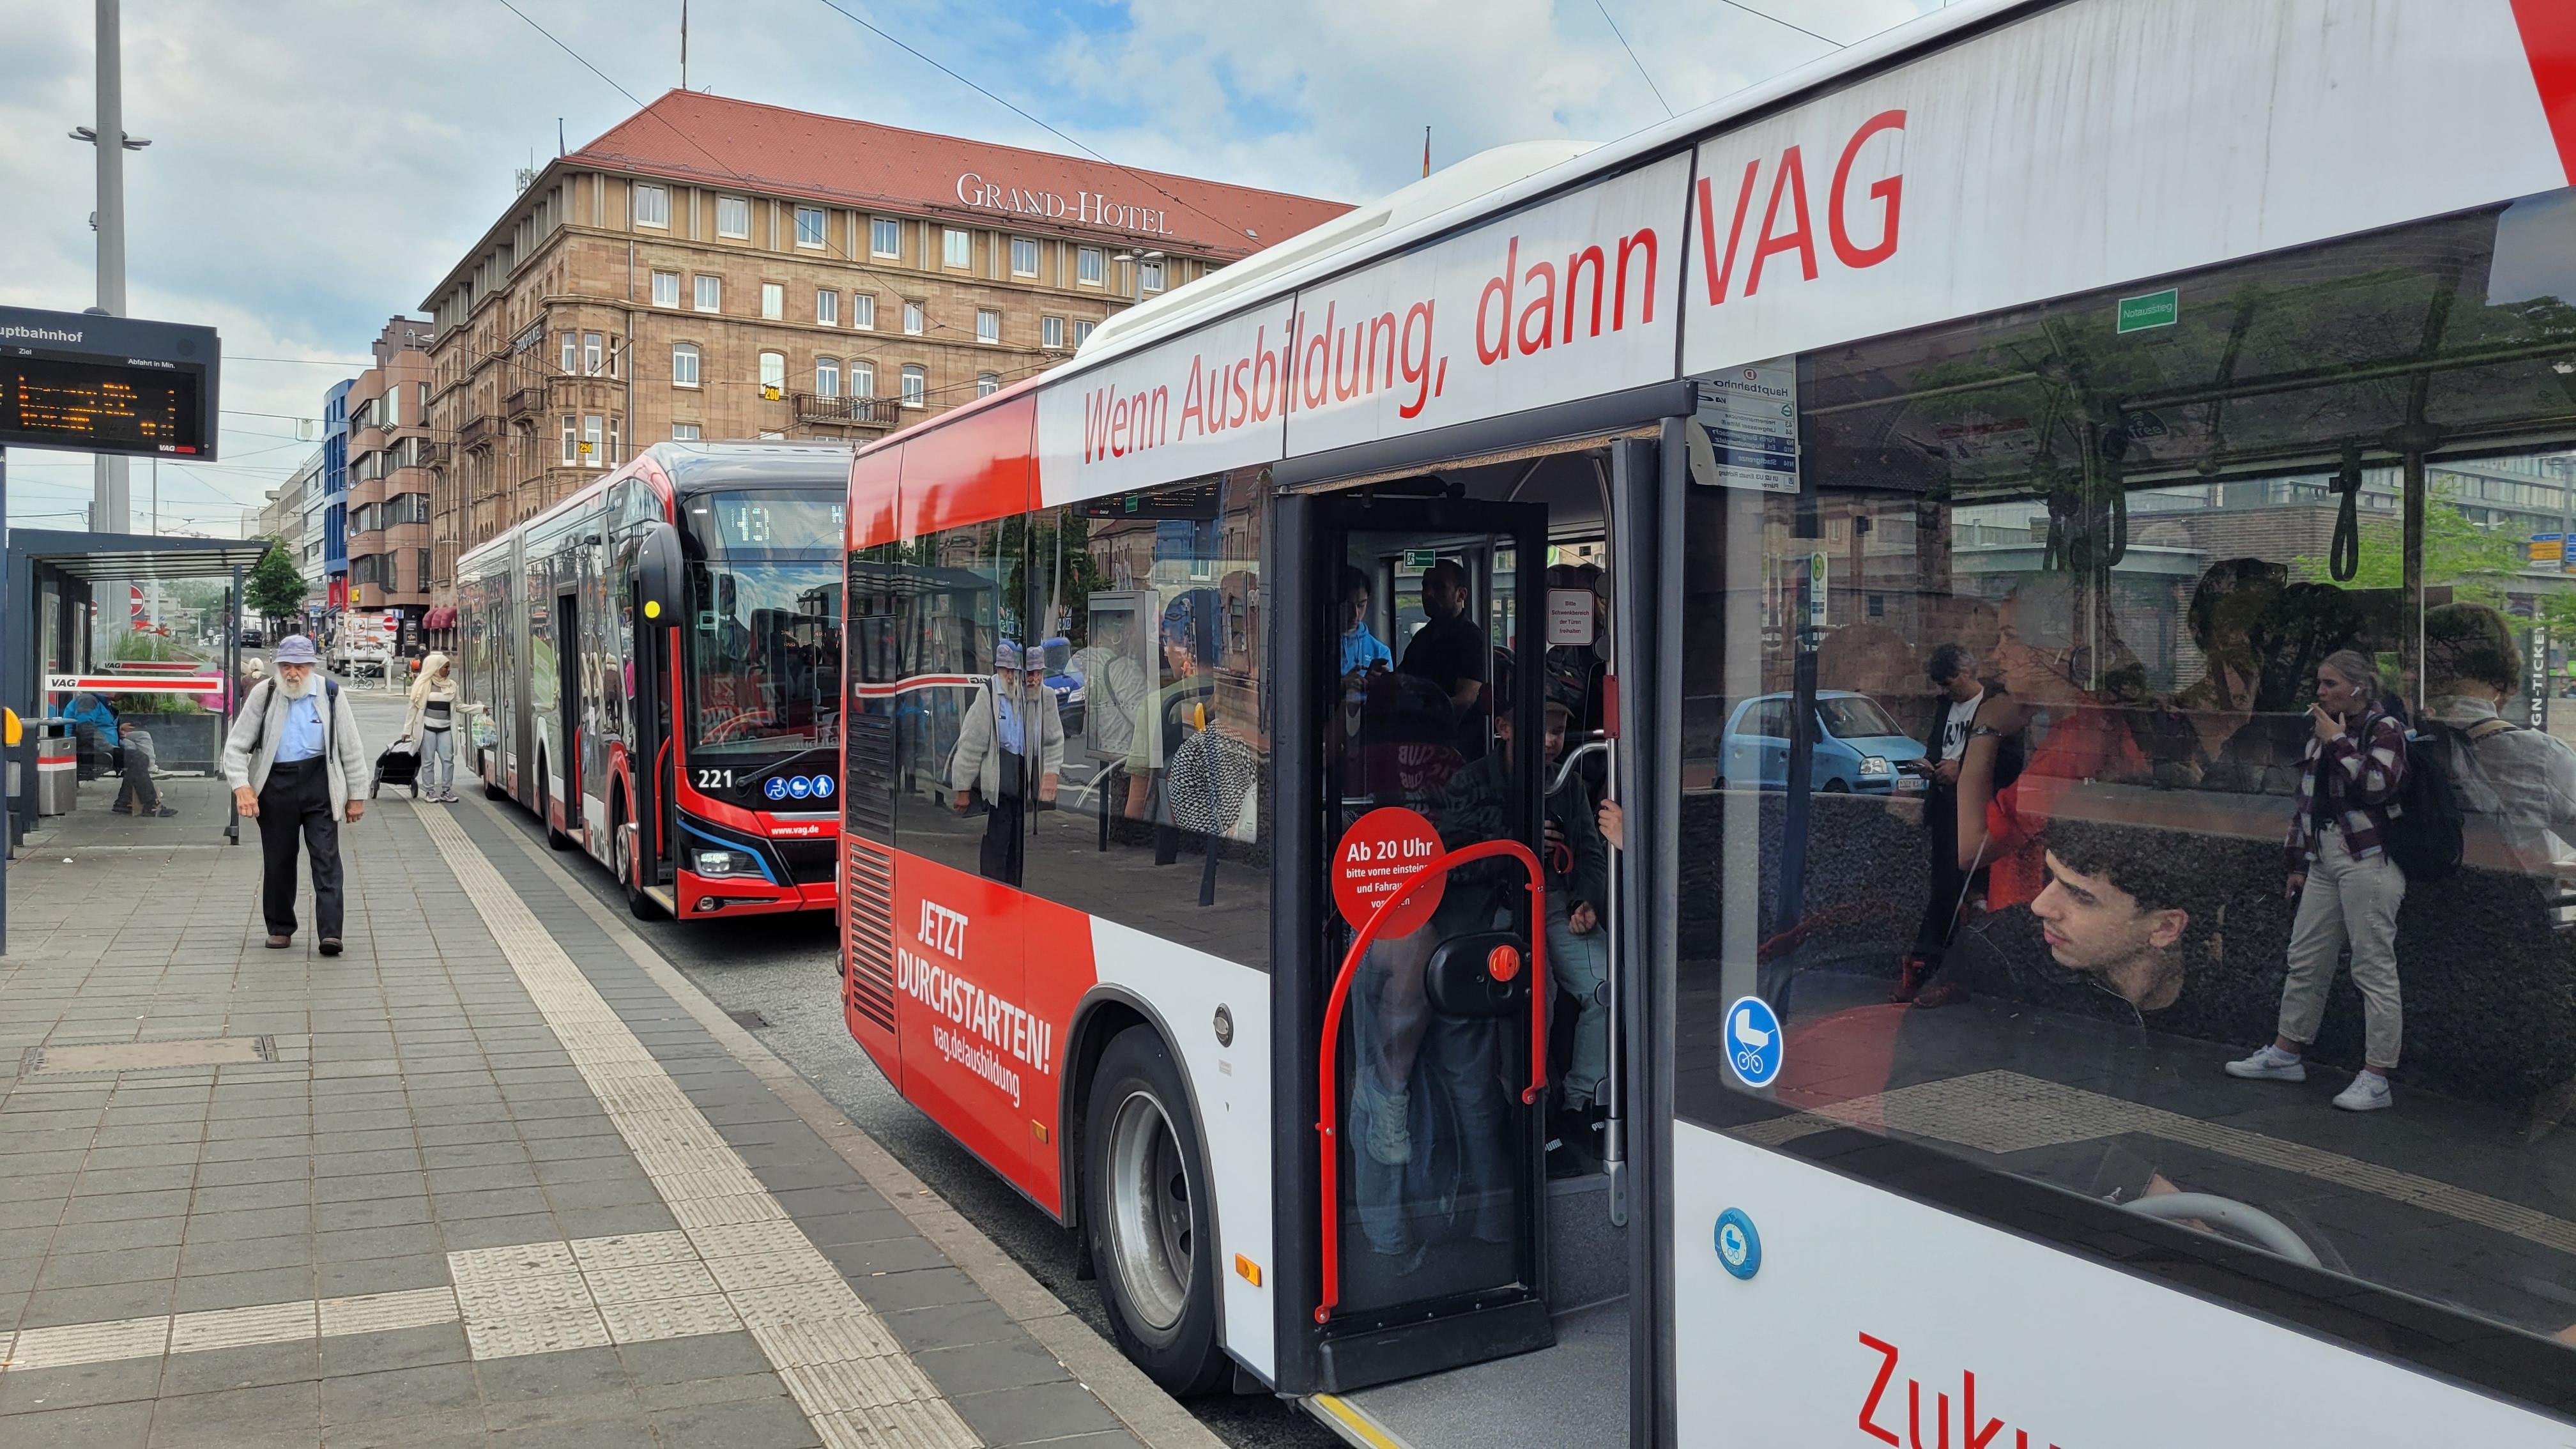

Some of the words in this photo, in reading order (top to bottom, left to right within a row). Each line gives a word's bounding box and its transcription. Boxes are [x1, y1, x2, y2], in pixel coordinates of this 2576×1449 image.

[956, 173, 1174, 235] GRAND-HOTEL
[1084, 381, 1167, 464] Wenn
[1177, 298, 1448, 441] Ausbildung,
[1475, 226, 1659, 366] dann
[1696, 109, 1908, 306] VAG
[128, 358, 153, 367] Abfahrt
[765, 387, 779, 401] 260
[579, 442, 592, 453] 250
[51, 679, 76, 687] VAG
[698, 769, 732, 788] 221
[771, 825, 819, 836] www.vag.de
[1346, 841, 1371, 862] Ab
[1376, 840, 1397, 859] 20
[1403, 838, 1433, 857] Uhr
[1346, 868, 1366, 878] bitte
[1368, 868, 1391, 876] vorne
[1357, 883, 1372, 894] und
[918, 899, 969, 960] JETZT
[898, 947, 1051, 1075] DURCHSTARTEN!
